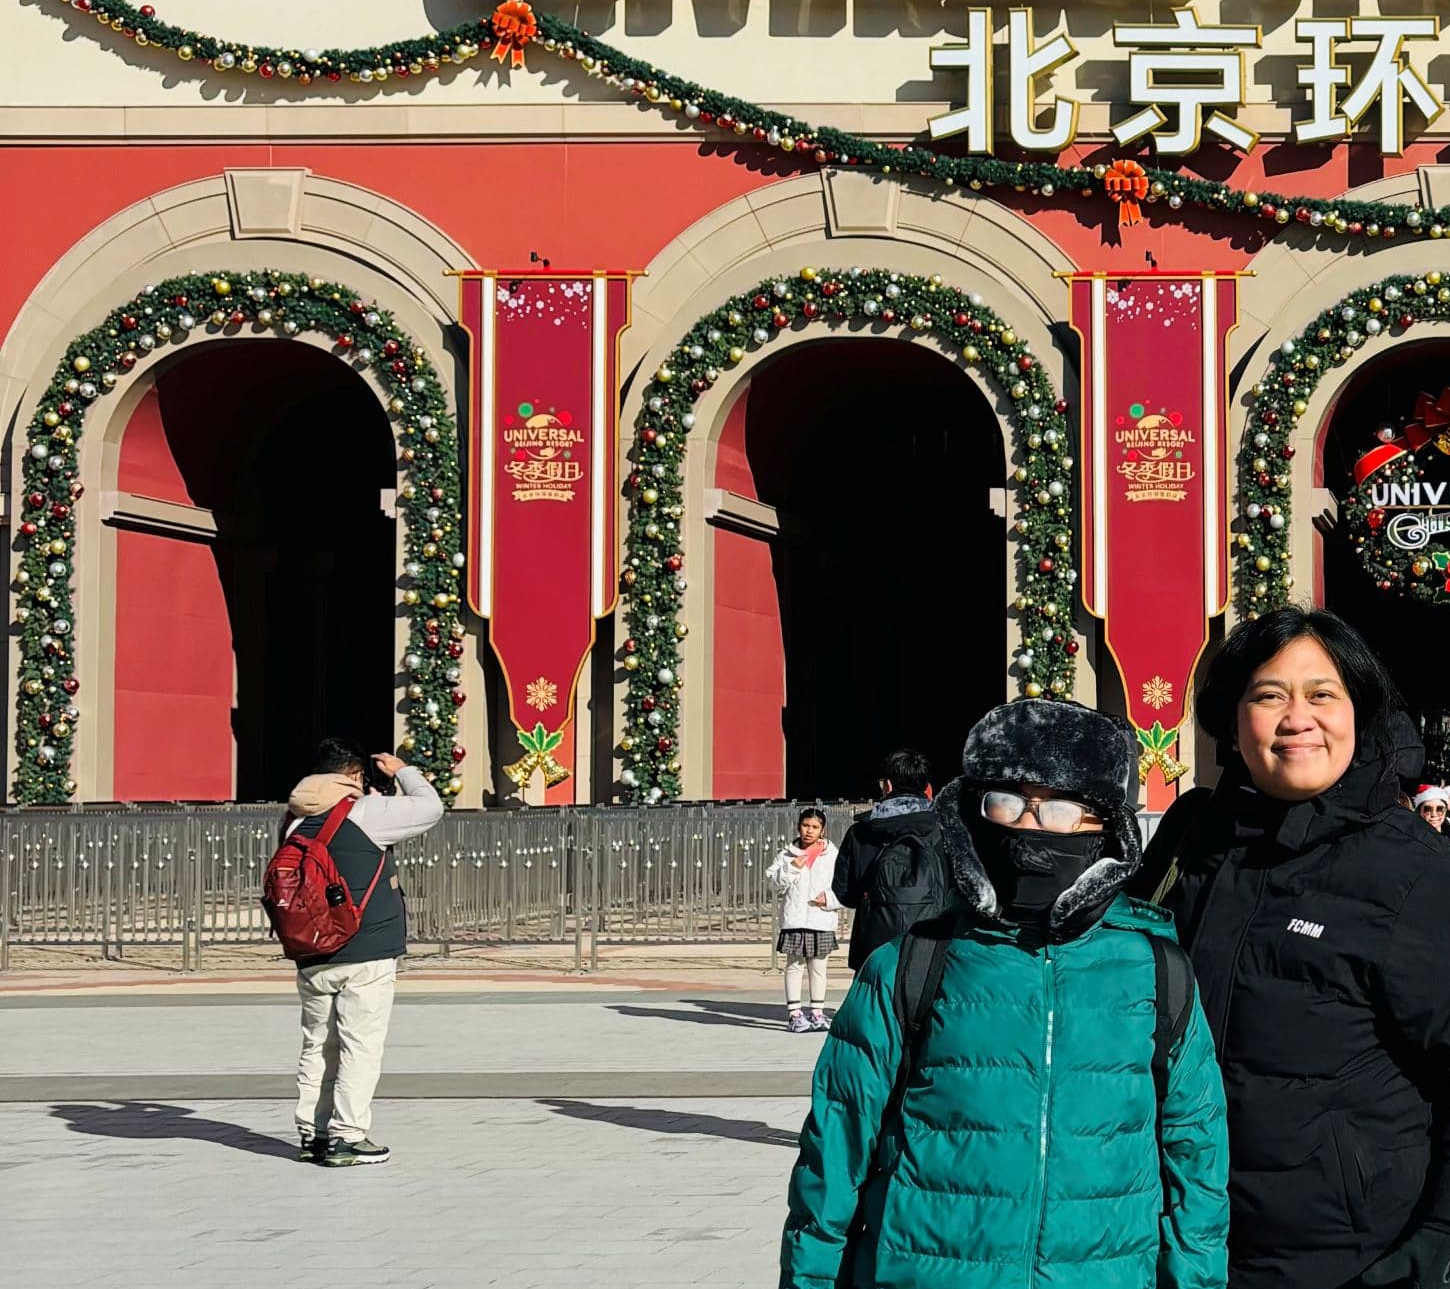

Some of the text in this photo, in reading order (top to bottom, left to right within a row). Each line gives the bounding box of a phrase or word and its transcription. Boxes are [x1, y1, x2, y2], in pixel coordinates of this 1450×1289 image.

[504, 428, 584, 443] UNIVERSAL
[1115, 429, 1196, 443] UNIVERSAL
[504, 460, 584, 483] 冬季假日
[1116, 461, 1195, 483] 冬季假日
[1286, 918, 1325, 939] FCMM
